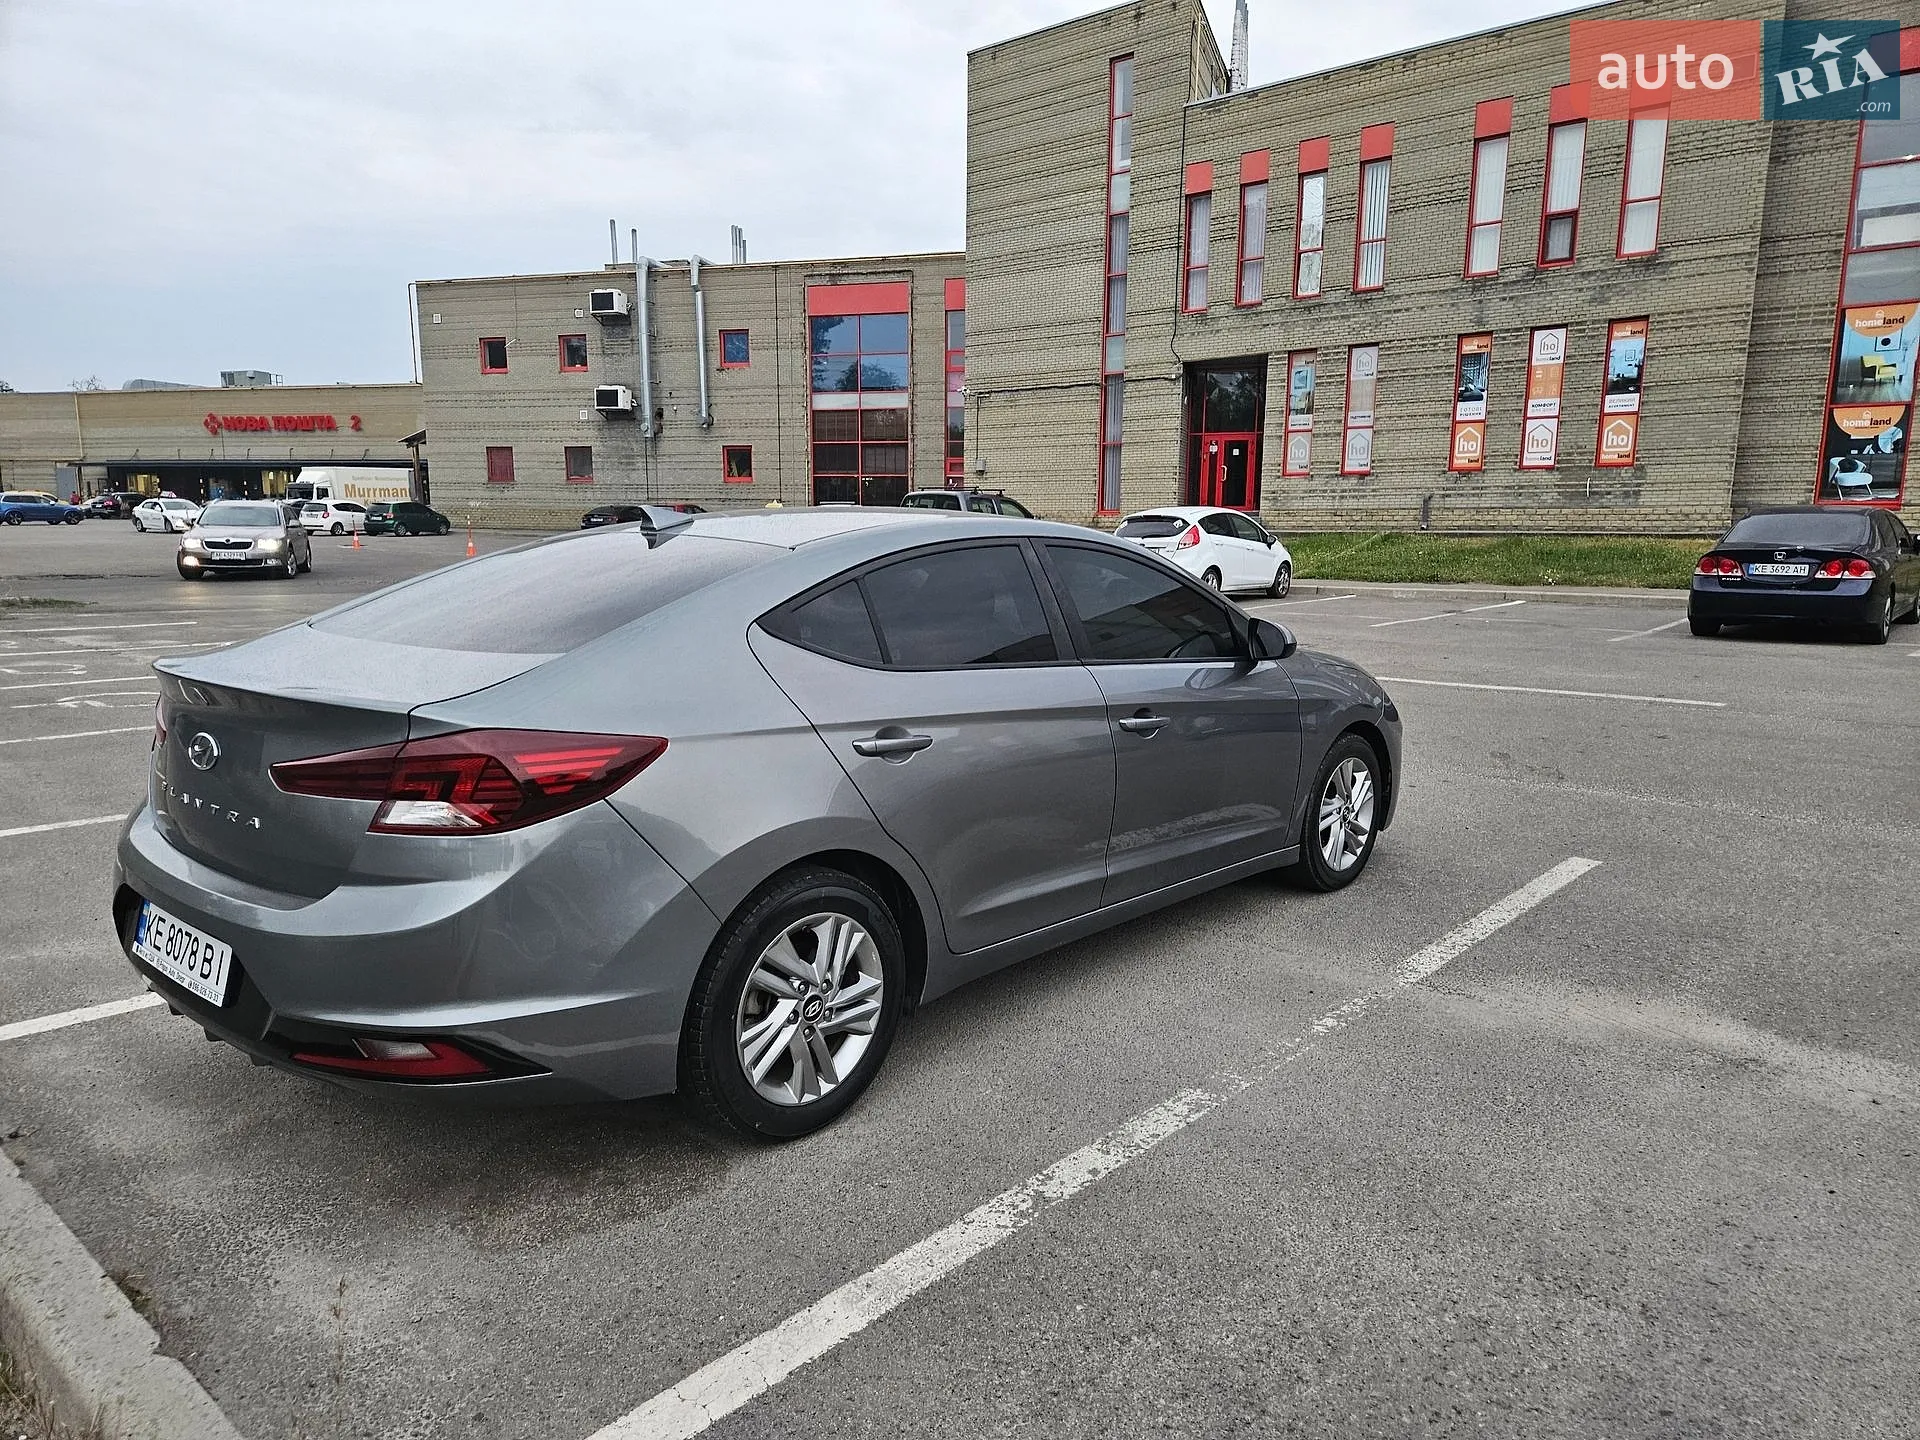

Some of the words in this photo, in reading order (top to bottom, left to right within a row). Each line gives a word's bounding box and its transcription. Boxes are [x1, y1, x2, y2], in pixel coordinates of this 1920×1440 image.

[1855, 315, 1906, 328] homeland
[1542, 340, 1556, 351] ho
[222, 415, 270, 431] НОВА
[271, 415, 337, 431] ПОШТА
[350, 414, 362, 431] 2
[1843, 417, 1892, 428] homeland
[1459, 437, 1477, 452] ho
[1530, 435, 1549, 449] ho
[1607, 431, 1628, 446] ho
[1291, 446, 1306, 458] ho
[1754, 564, 1768, 573] KE
[1770, 565, 1791, 574] 3692
[1792, 566, 1806, 574] AH
[161, 780, 262, 829] ELANTRA
[144, 910, 166, 952] KE
[165, 923, 199, 972] 8078
[200, 942, 224, 986] BI
